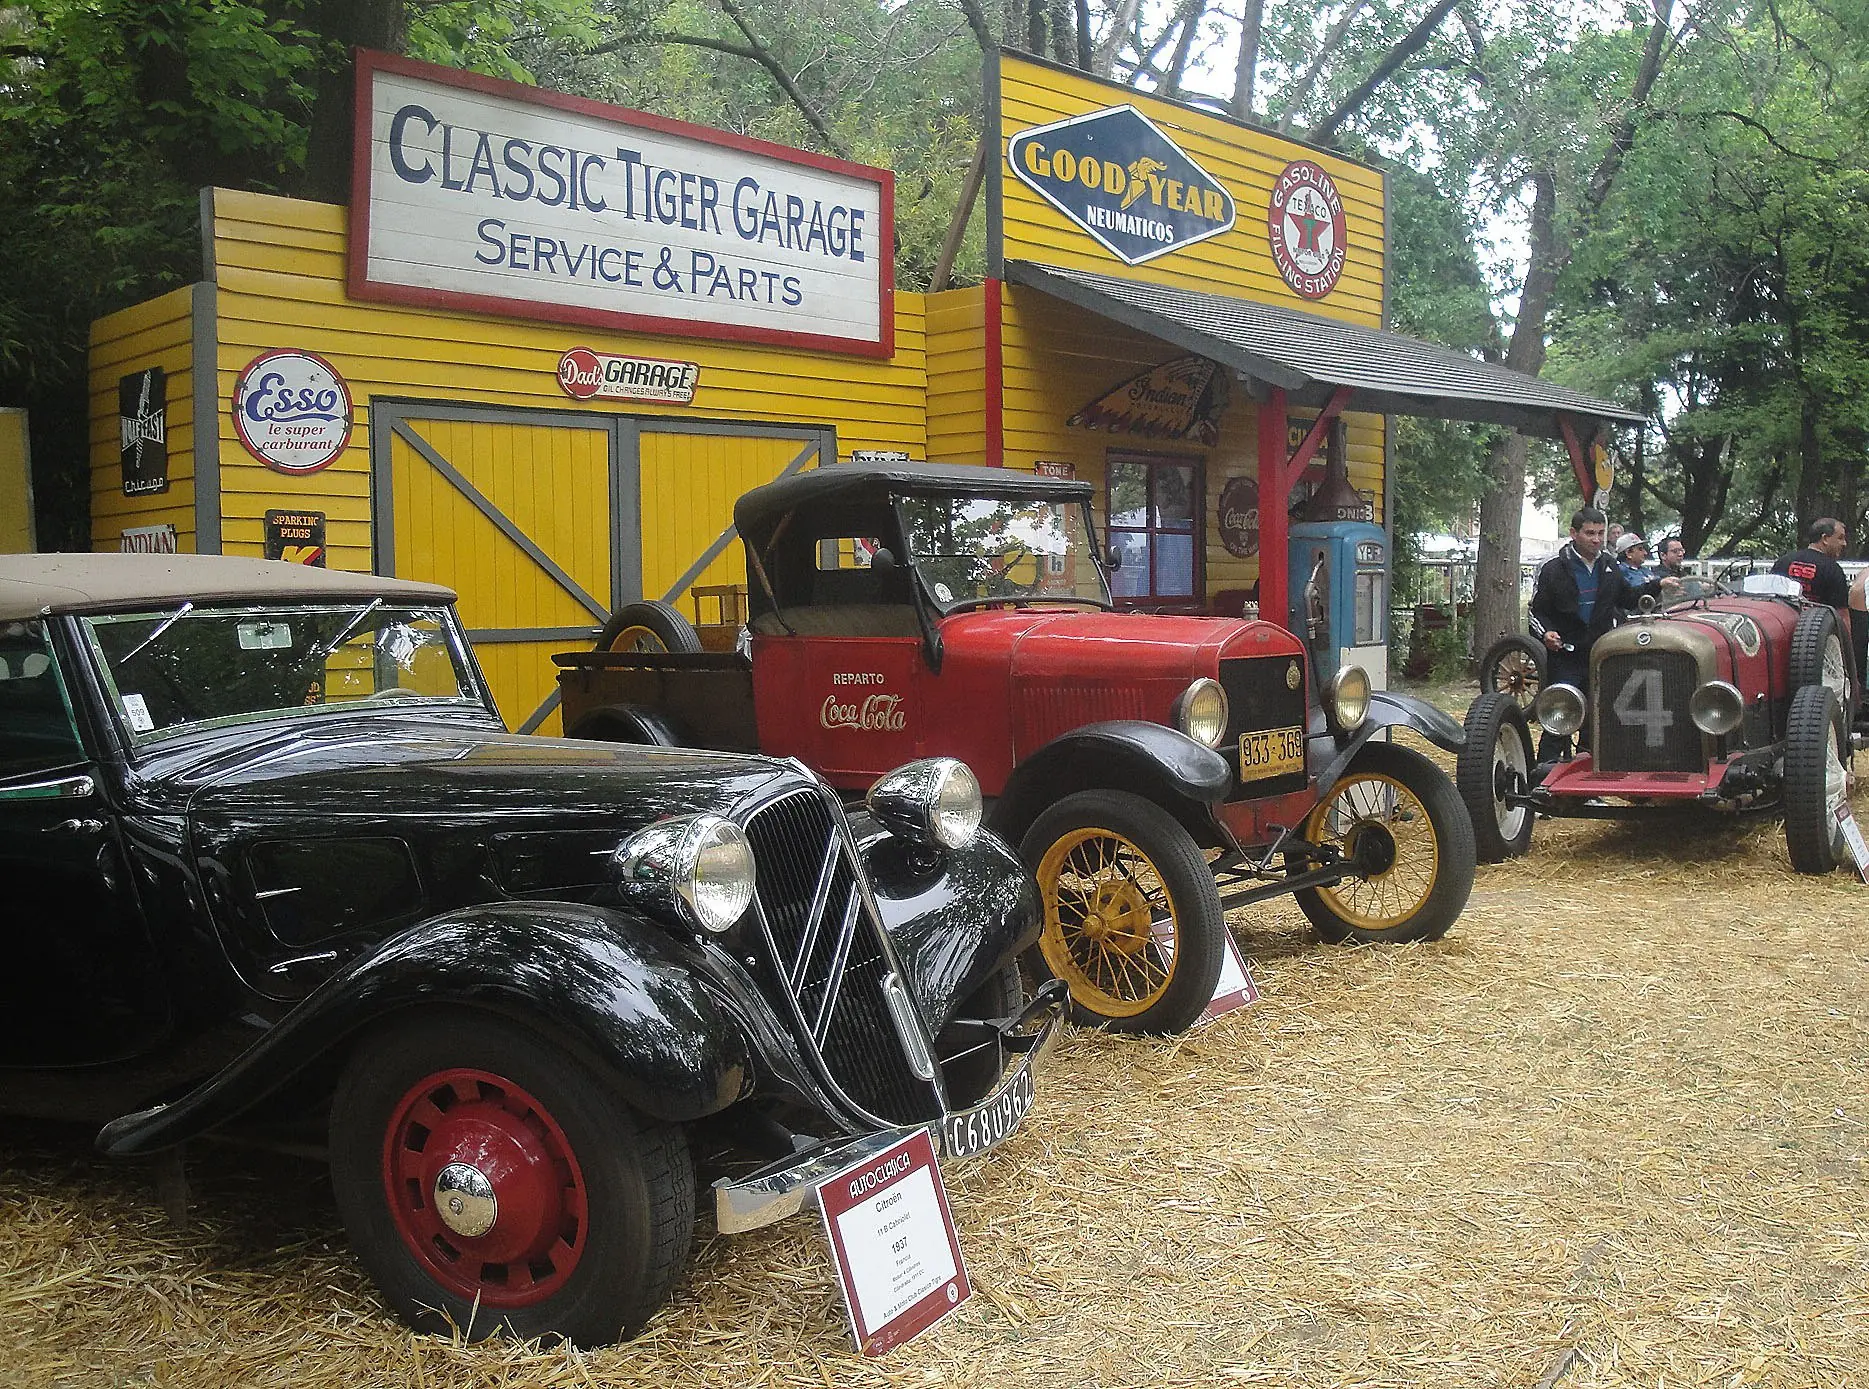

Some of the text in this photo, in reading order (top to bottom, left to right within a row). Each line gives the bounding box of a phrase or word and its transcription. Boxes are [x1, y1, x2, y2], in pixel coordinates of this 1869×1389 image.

[389, 104, 866, 262] CLASSIC TIGER GARAGE
[1274, 166, 1342, 217] GASOLINE
[1087, 204, 1175, 244] NEUMATICOS
[474, 218, 803, 306] SERVICE & PARTS
[1272, 224, 1344, 293] FILLING STATION
[562, 358, 604, 386] Dad's
[605, 360, 693, 389] GARAGE
[245, 372, 340, 422] Esso
[615, 387, 644, 395] CHANGES
[262, 438, 333, 450] carburant
[268, 424, 326, 438] le super
[124, 477, 164, 493] Chicago
[280, 528, 311, 539] PLUGS
[833, 673, 885, 685] REPARTO
[1613, 668, 1674, 748] 4
[953, 1070, 1032, 1157] C680962
[875, 1192, 903, 1213] Citroën
[891, 1236, 908, 1254] 1937
